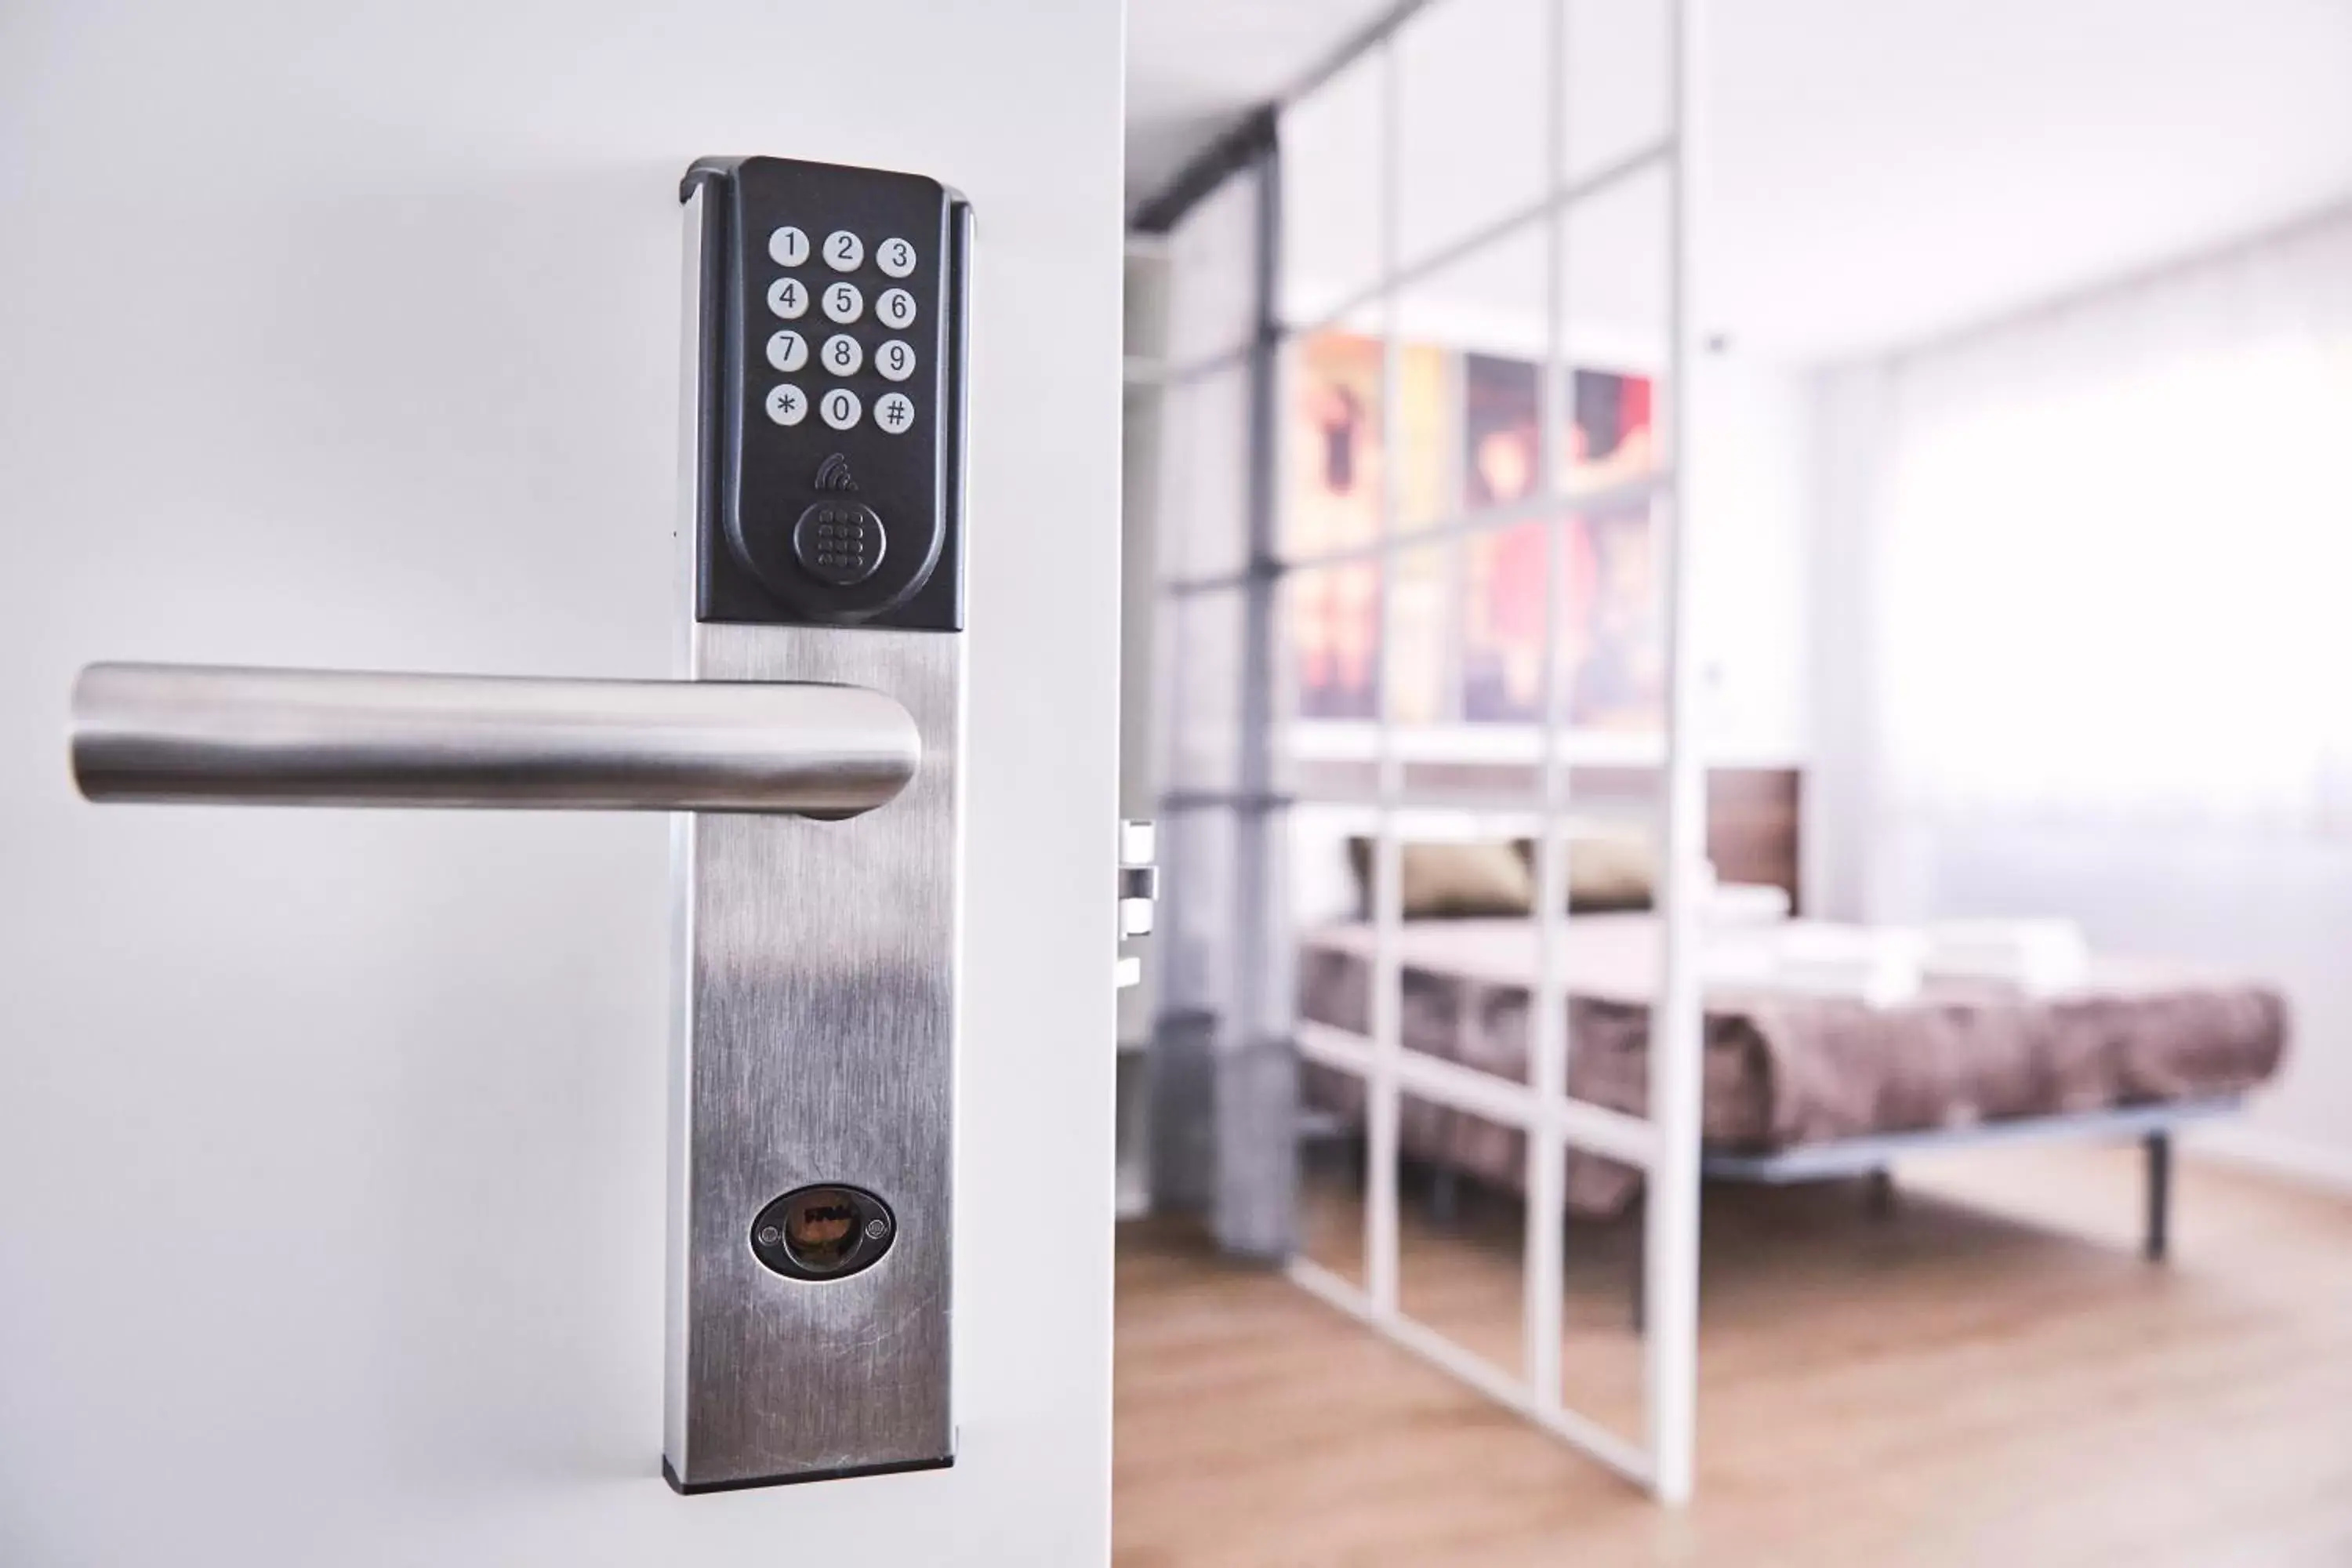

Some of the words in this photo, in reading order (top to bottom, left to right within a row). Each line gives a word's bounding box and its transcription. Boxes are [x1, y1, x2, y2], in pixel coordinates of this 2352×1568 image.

[786, 231, 795, 256] 1
[837, 235, 853, 260] 2
[892, 243, 907, 267] 3
[779, 283, 797, 308] 4
[836, 288, 851, 313] 5
[891, 294, 907, 319] 6
[780, 336, 794, 361] 7
[834, 340, 851, 366] 8
[890, 346, 905, 371] 9
[833, 395, 850, 421] 0
[887, 401, 905, 426] #
